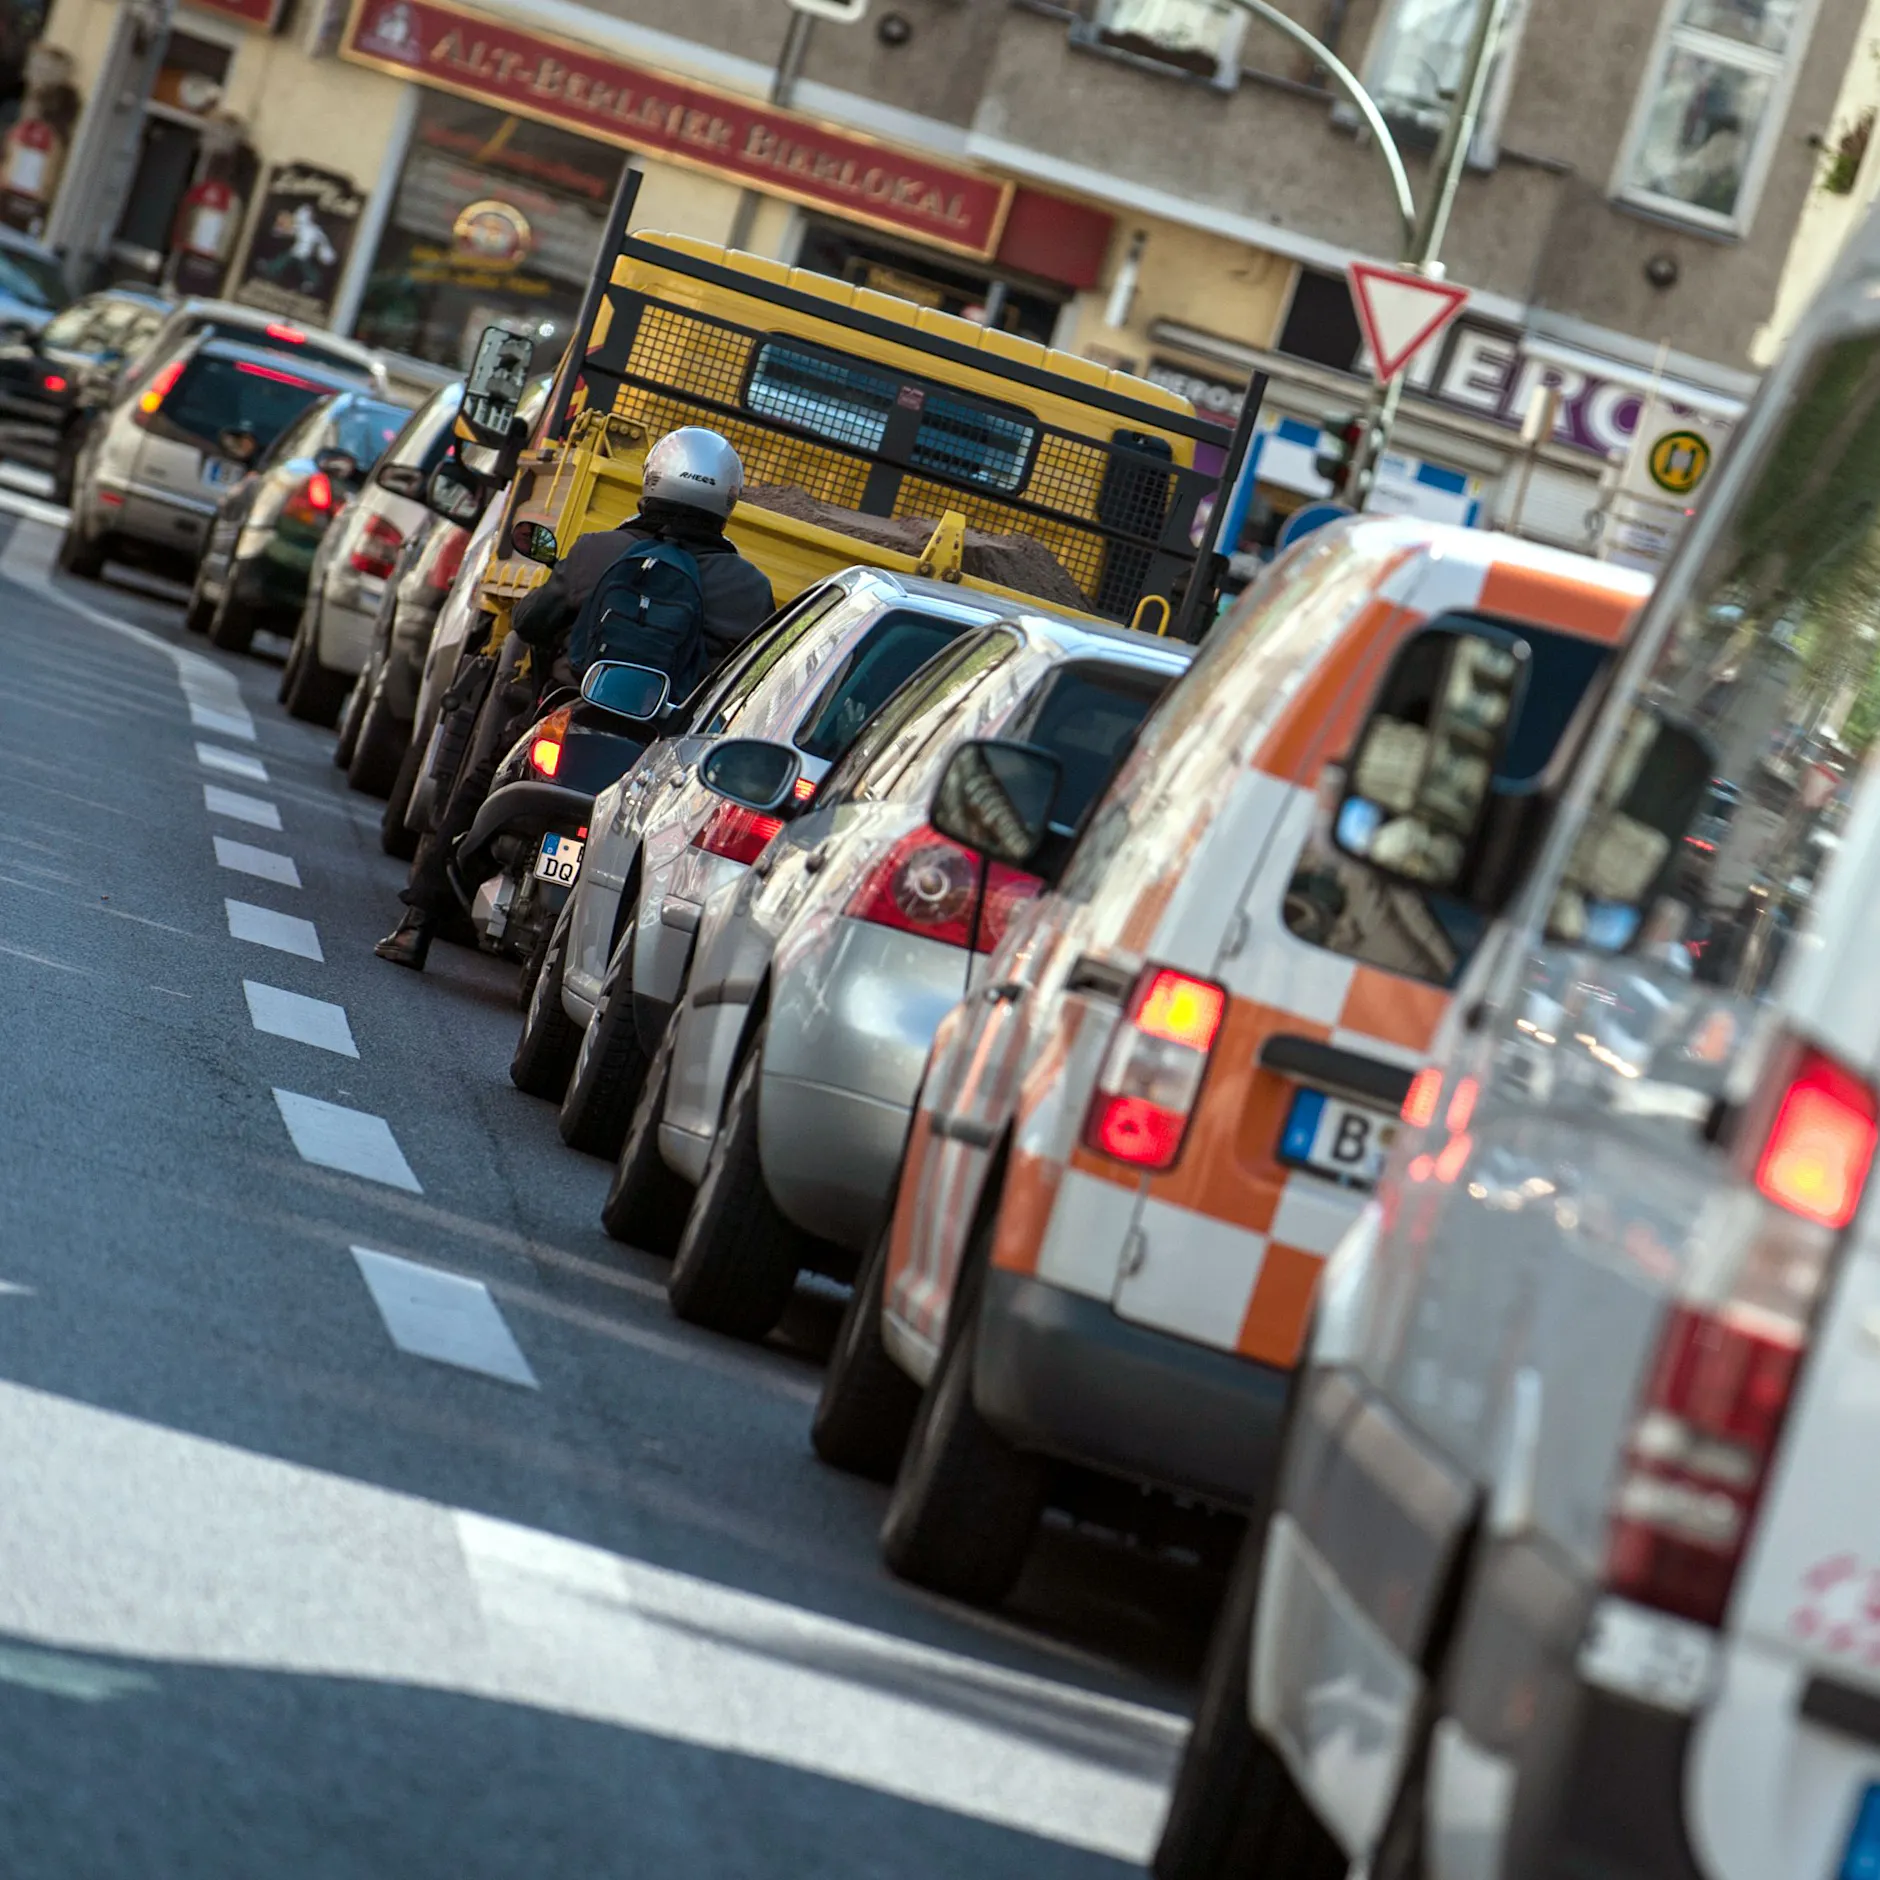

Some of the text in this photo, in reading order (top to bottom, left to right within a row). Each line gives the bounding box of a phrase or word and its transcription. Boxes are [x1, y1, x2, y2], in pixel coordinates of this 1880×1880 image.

[741, 122, 971, 230] BIERLOKAL
[543, 857, 573, 881] DQ
[1331, 1112, 1371, 1164] B
